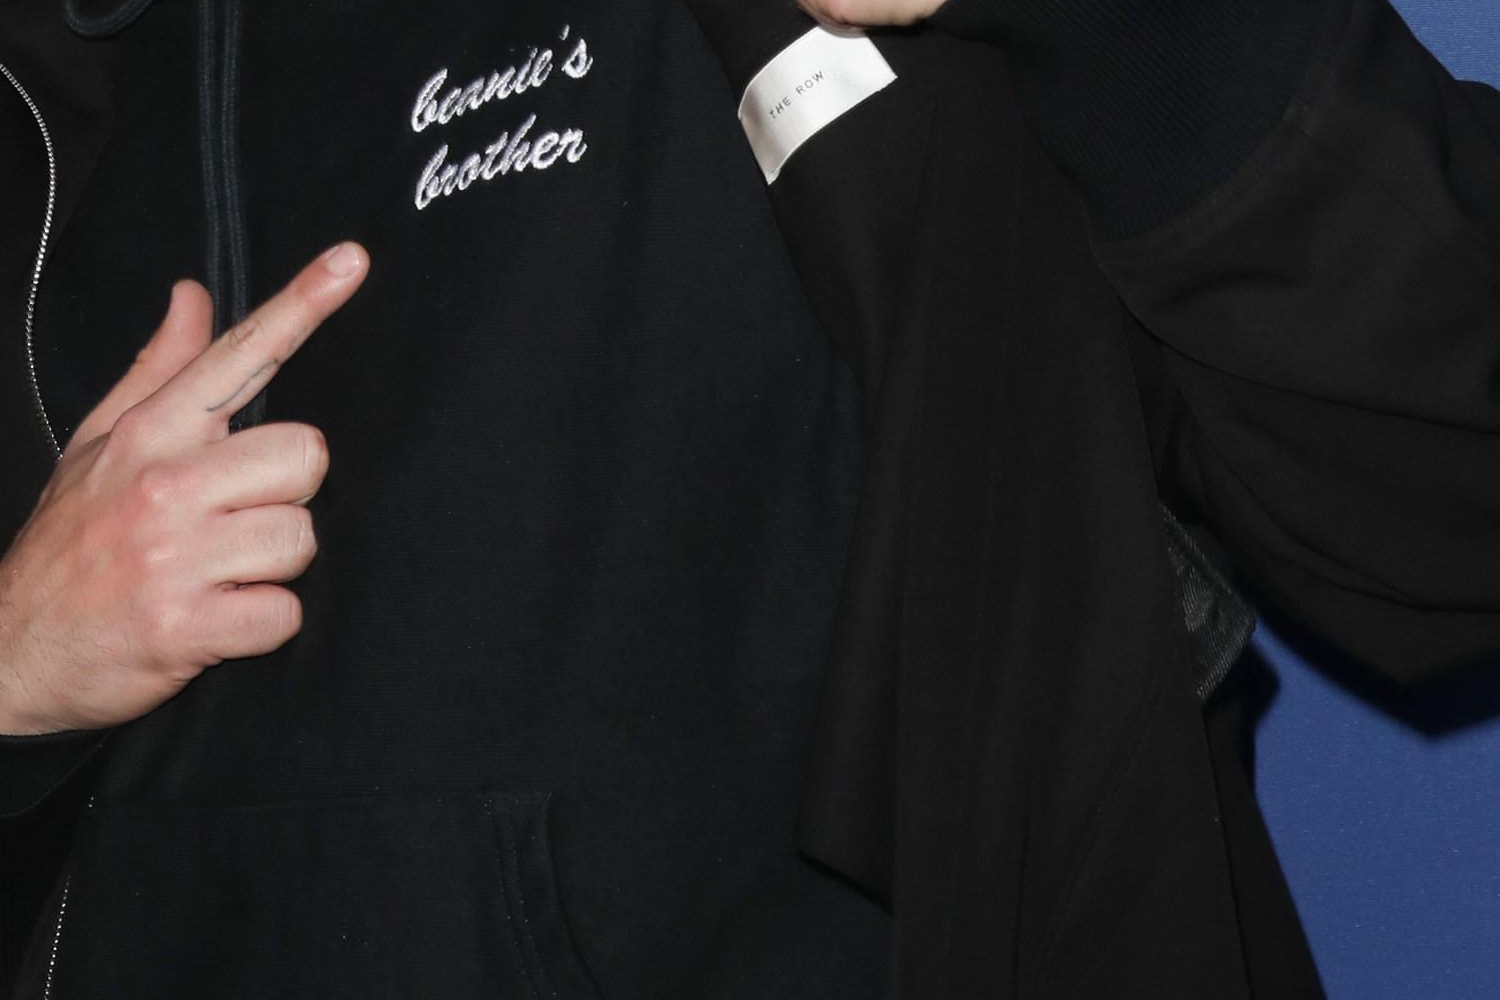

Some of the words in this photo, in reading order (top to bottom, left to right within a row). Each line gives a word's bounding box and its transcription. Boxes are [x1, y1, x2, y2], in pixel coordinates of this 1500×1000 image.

[410, 24, 594, 133] beanie's
[769, 96, 792, 119] THE
[795, 70, 825, 96] ROW
[414, 113, 588, 211] brother
